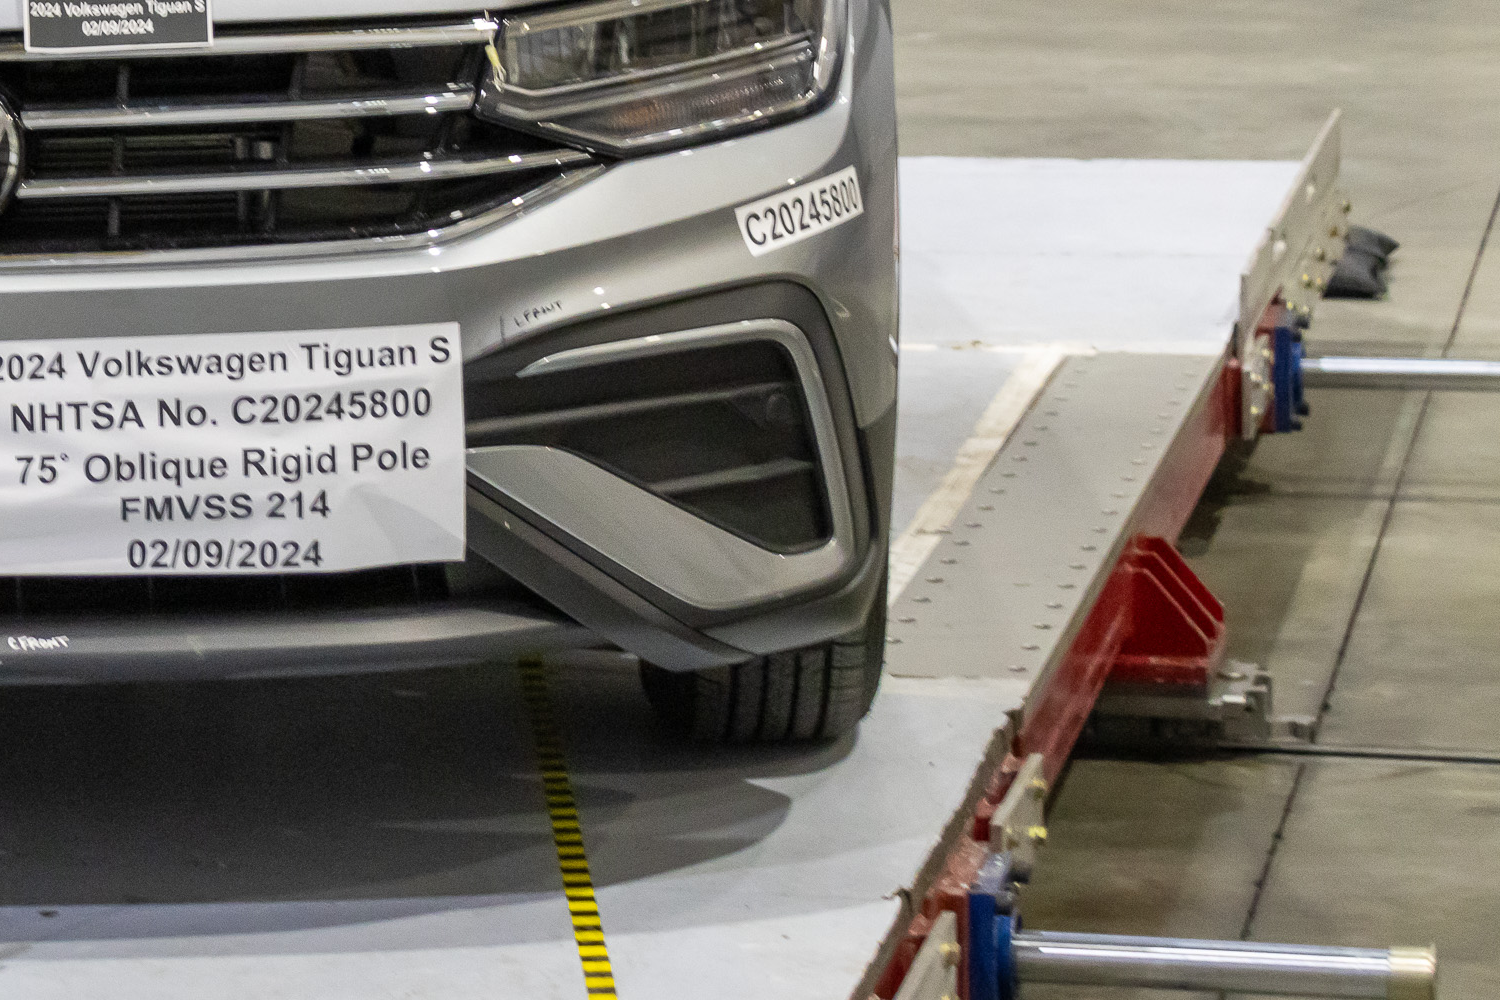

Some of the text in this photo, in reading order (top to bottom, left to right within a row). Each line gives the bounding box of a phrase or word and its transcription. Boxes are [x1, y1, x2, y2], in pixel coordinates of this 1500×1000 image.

[30, 2, 62, 17] 2024
[63, 2, 144, 18] Volkswagen
[146, 0, 193, 18] Tiguan
[82, 18, 154, 36] 02/09/2024
[746, 177, 858, 246] C20245800
[76, 347, 288, 380] Volkswagen
[300, 341, 416, 375] Tiguan
[429, 337, 451, 363] S
[12, 388, 431, 432] NHTSA No. C20245800
[84, 453, 228, 485] Oblique
[243, 444, 337, 482] Rigid
[352, 442, 430, 471] Pole
[121, 491, 330, 521] FMVSS 214
[127, 540, 323, 569] 02/09/2024
